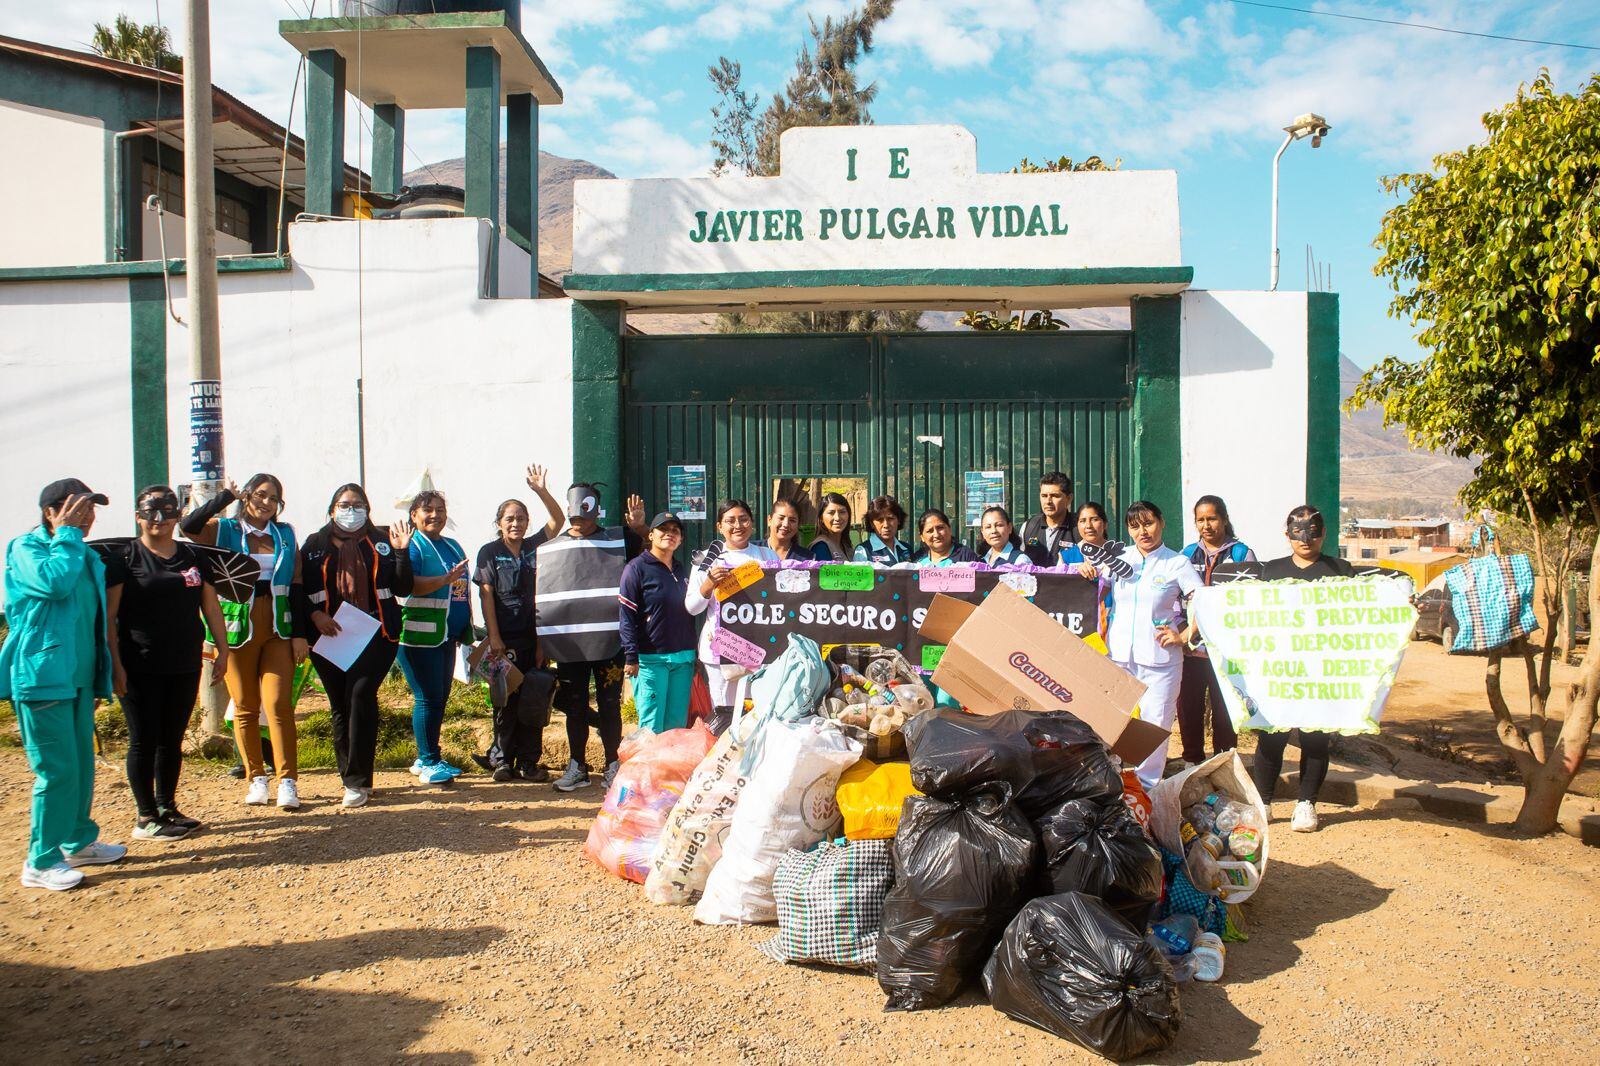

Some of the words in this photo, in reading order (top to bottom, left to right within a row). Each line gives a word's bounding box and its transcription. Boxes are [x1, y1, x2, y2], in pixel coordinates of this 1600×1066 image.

[846, 148, 858, 181] I
[888, 147, 910, 179] E
[689, 209, 804, 243] JAVIER
[819, 206, 956, 240] PULGAR
[968, 203, 1069, 238] VIDAL
[1226, 589, 1245, 606] SI
[1261, 588, 1284, 605] EL
[1301, 584, 1377, 605] DENGUE
[721, 602, 785, 625] COLE
[1223, 609, 1305, 629] QUIERES
[1317, 606, 1413, 627] PREVENIR
[1240, 634, 1276, 652] LOS
[1291, 632, 1399, 652] DEPOSITOS
[1009, 651, 1073, 703] Camuz
[1227, 658, 1249, 675] DE
[1262, 659, 1308, 677] AGUA
[1322, 658, 1386, 677] DEBES
[1268, 681, 1364, 700] DESTRUIR
[675, 793, 703, 829] Extra
[678, 831, 706, 876] Cianir
